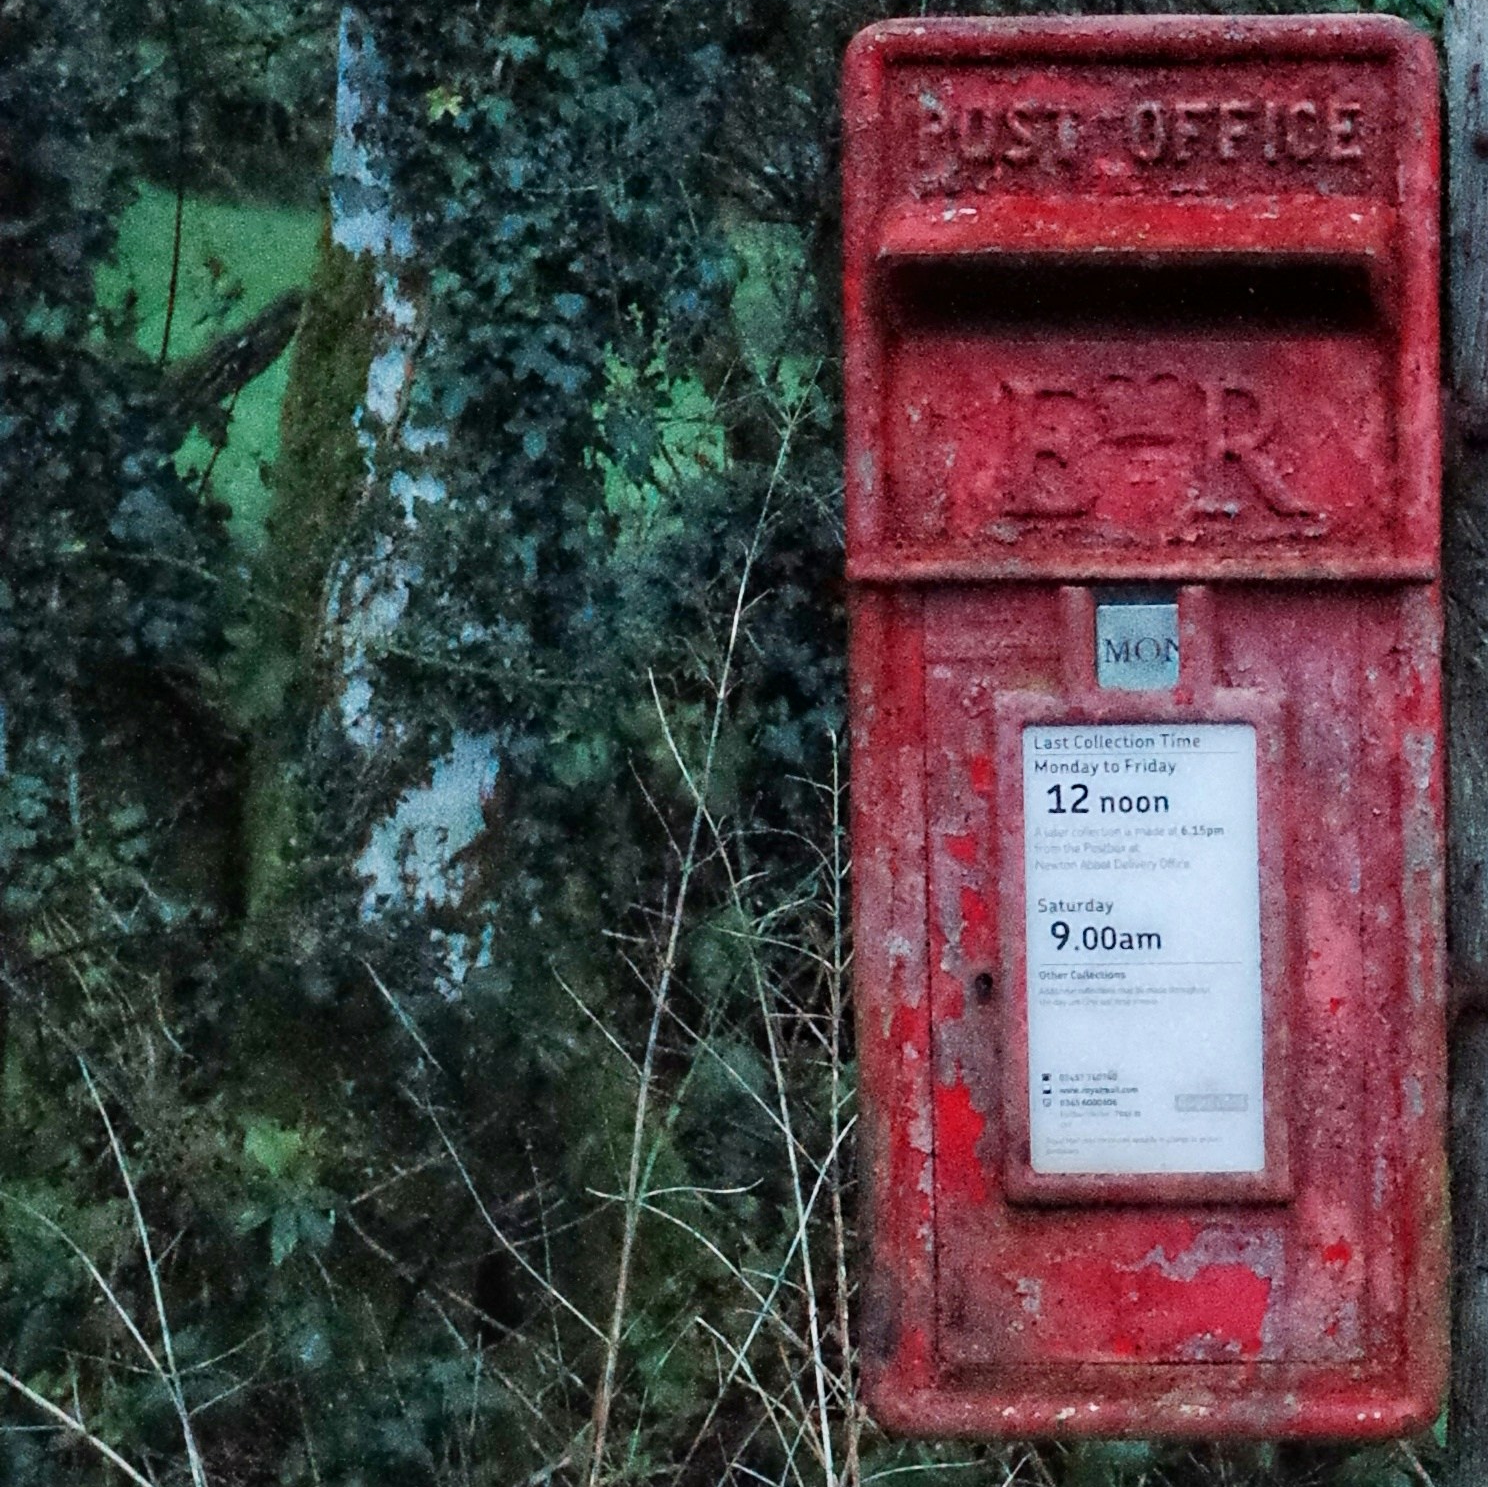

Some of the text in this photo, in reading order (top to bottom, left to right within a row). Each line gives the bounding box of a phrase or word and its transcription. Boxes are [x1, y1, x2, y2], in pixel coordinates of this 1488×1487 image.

[918, 99, 1364, 161] POST OFFICE
[1034, 733, 1200, 750] Last Collection Time
[1034, 758, 1177, 776] Monday to Friday
[1046, 783, 1170, 814] 12 noon
[1180, 825, 1225, 838] 6.15pm
[1038, 898, 1114, 915] Saturday
[1050, 920, 1162, 951] 9.00am
[1039, 970, 1126, 980] Other Collections
